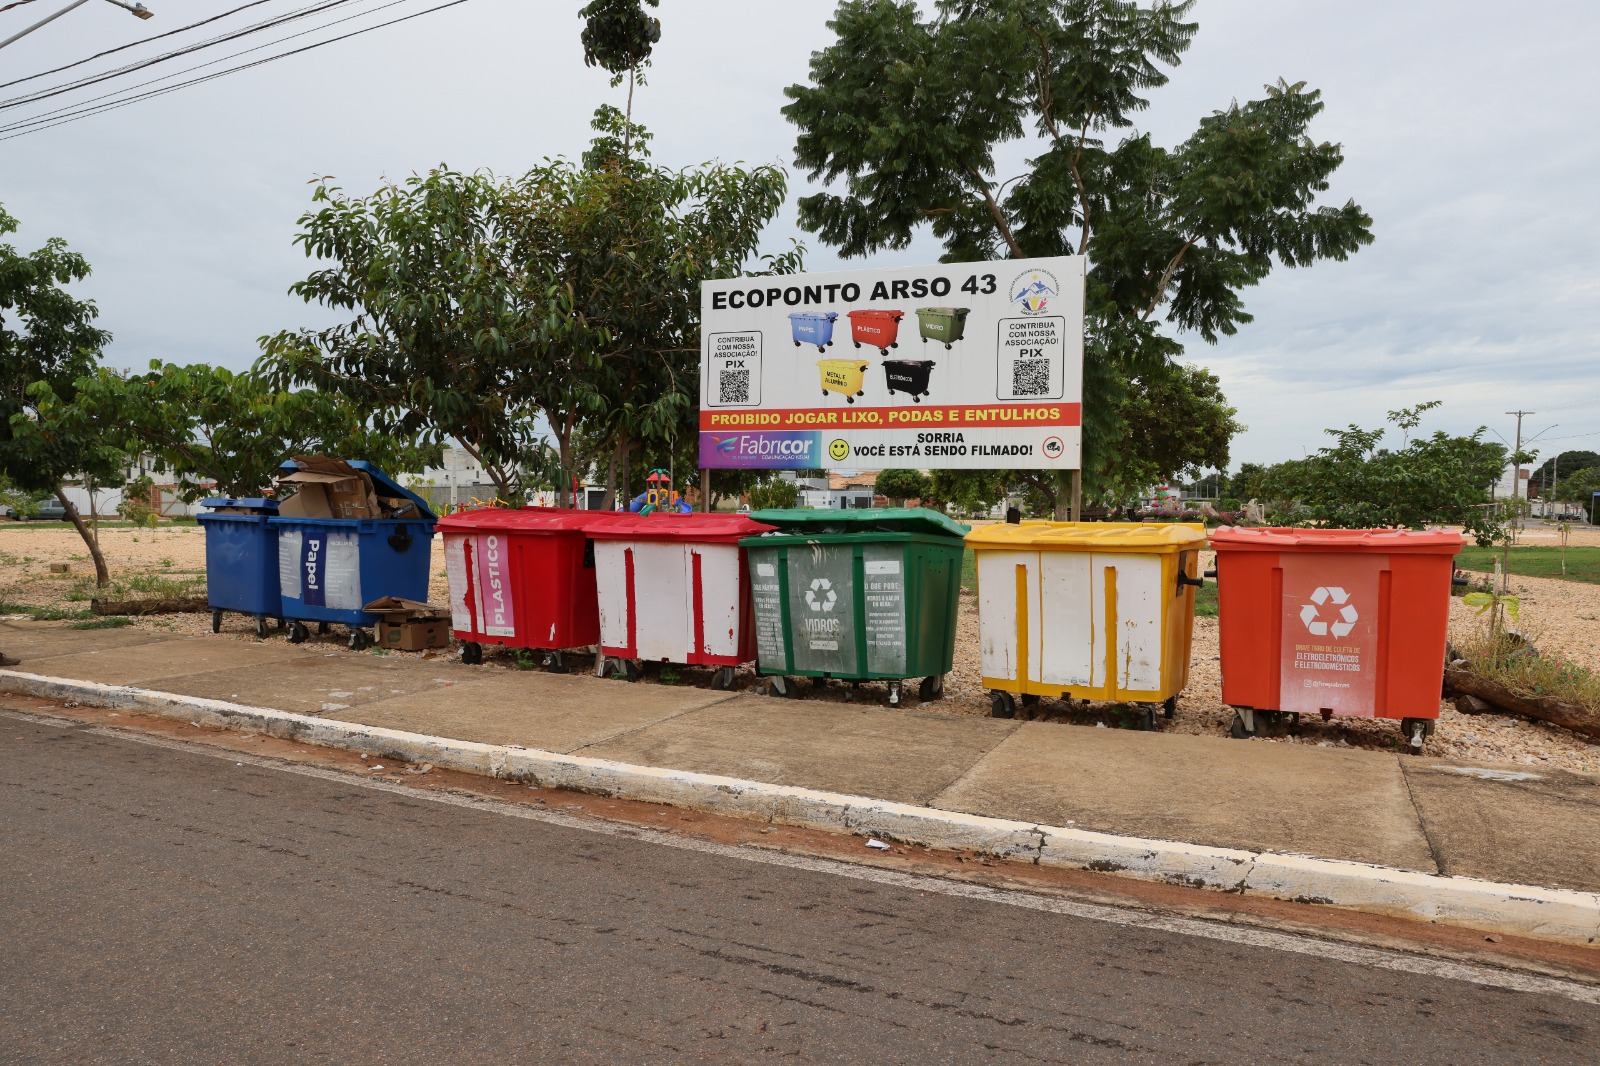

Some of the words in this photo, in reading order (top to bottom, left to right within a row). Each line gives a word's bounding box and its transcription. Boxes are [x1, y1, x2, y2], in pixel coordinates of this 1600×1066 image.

[712, 282, 860, 310] ECOPONTO
[870, 277, 951, 300] ARSO
[961, 274, 997, 294] 43
[926, 323, 944, 332] VIDRO
[1005, 337, 1058, 346] ASSOCIAÇÃO!
[714, 350, 758, 358] ASSOCIAÇÃO!
[1020, 348, 1042, 358] PIX
[826, 371, 842, 380] METAL
[711, 414, 780, 424] PROIBIDO
[785, 412, 838, 424] JOGAR
[842, 412, 883, 424] LIXO,
[888, 410, 944, 422] PODAS
[949, 410, 959, 421] E
[965, 408, 1060, 420] ENTULHOS
[918, 432, 964, 443] SORRIA
[740, 434, 812, 454] Fabricor
[854, 444, 885, 456] VOCÊ
[889, 444, 920, 456] ESTÁ
[924, 445, 967, 456] SENDO
[971, 445, 1032, 456] FILMADO!
[306, 540, 320, 590] Papel
[487, 536, 505, 624] PLASTICO
[805, 618, 839, 632] VIDROS
